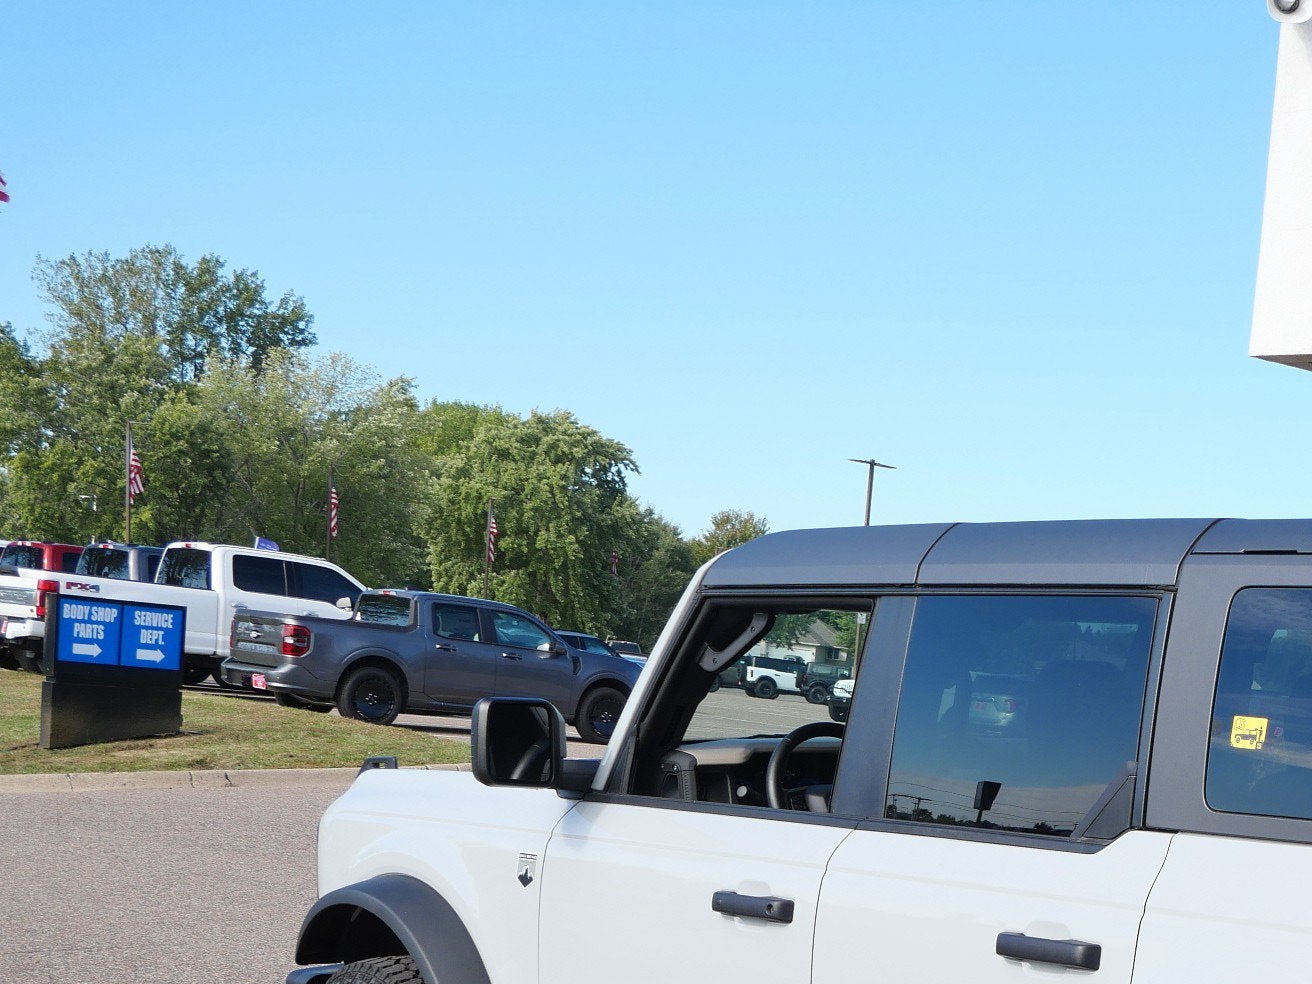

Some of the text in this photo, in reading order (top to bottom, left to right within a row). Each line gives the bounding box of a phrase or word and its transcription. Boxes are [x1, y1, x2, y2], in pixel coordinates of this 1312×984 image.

[63, 603, 118, 623] BODY SHOP
[134, 610, 174, 629] SERVICE
[73, 622, 105, 640] PARTS
[139, 629, 165, 645] DEPT.
